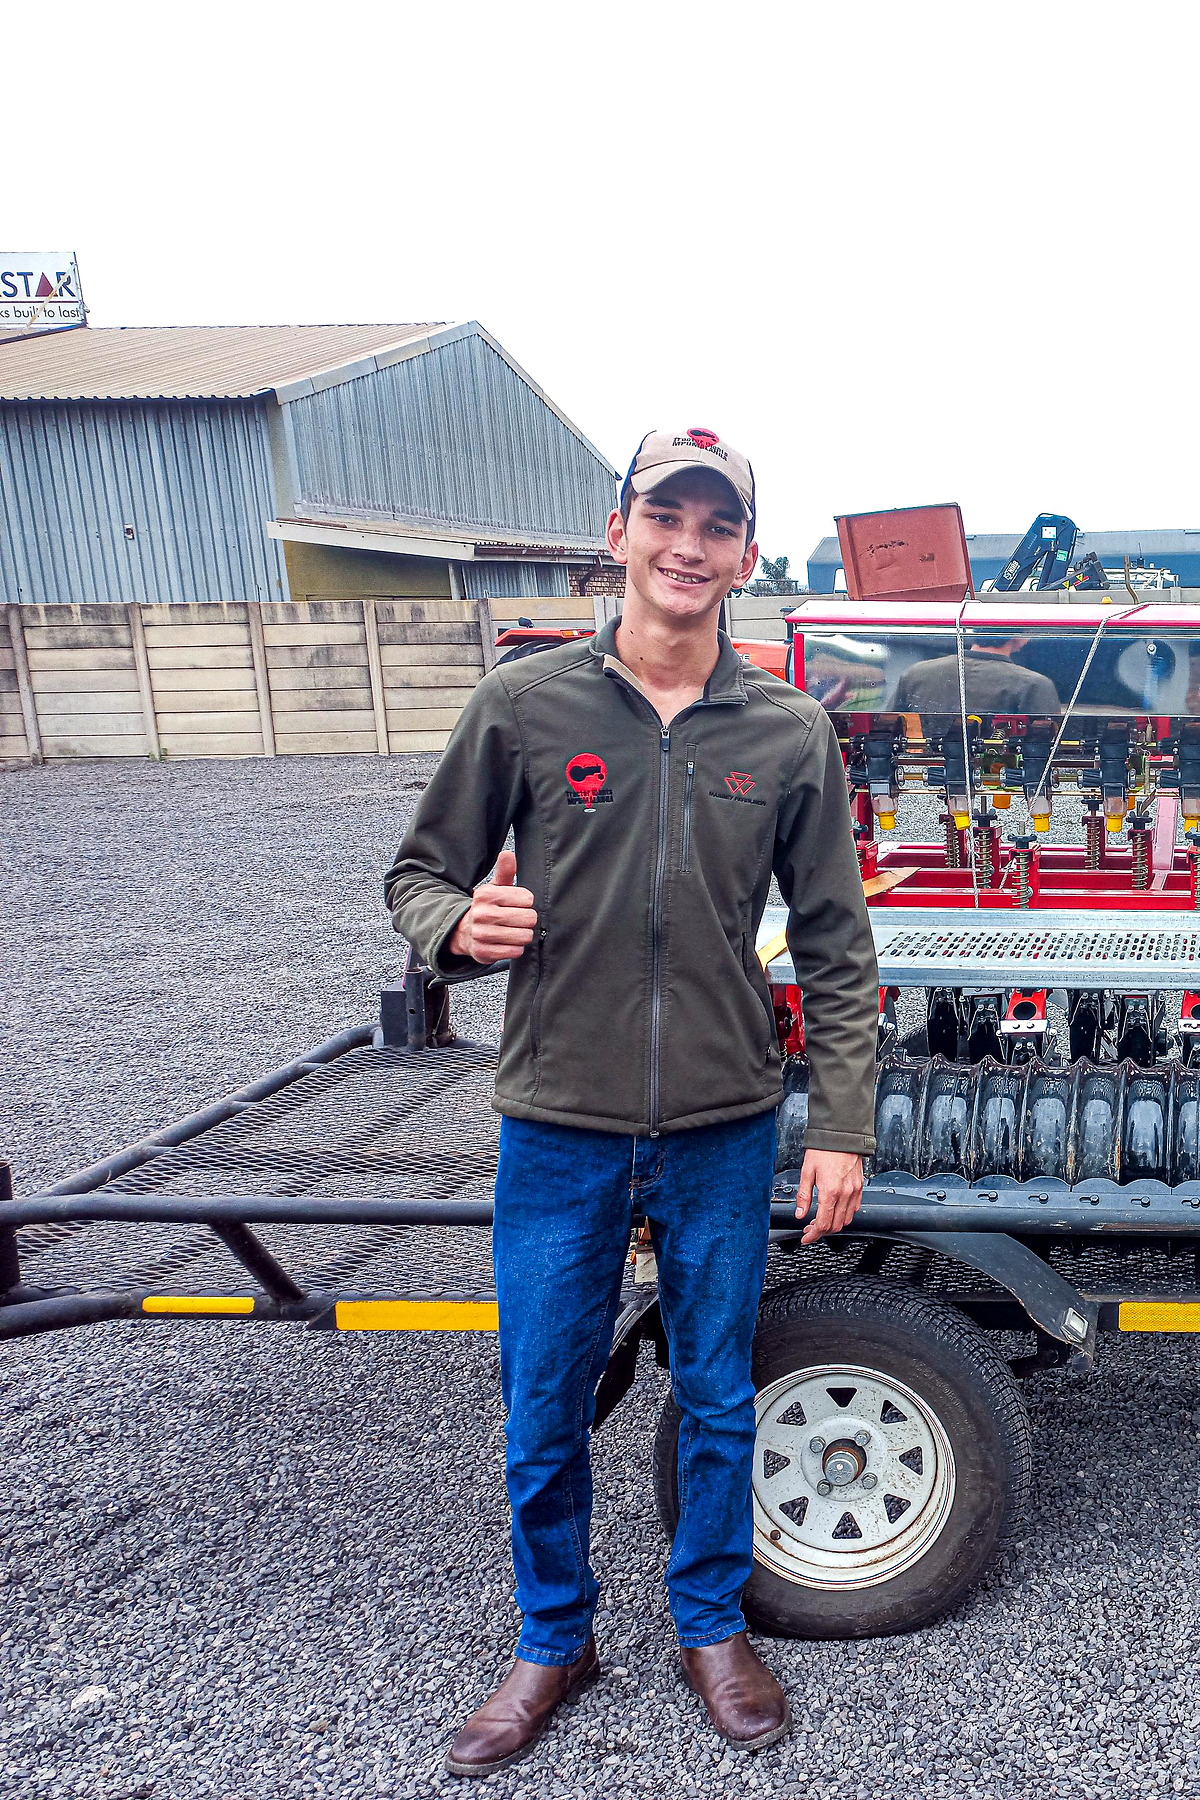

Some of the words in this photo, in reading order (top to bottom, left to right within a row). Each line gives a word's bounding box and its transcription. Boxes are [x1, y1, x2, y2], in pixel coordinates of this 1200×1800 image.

[0, 271, 76, 297] STAR
[13, 306, 40, 318] buil
[44, 307, 55, 318] to
[59, 306, 80, 318] last
